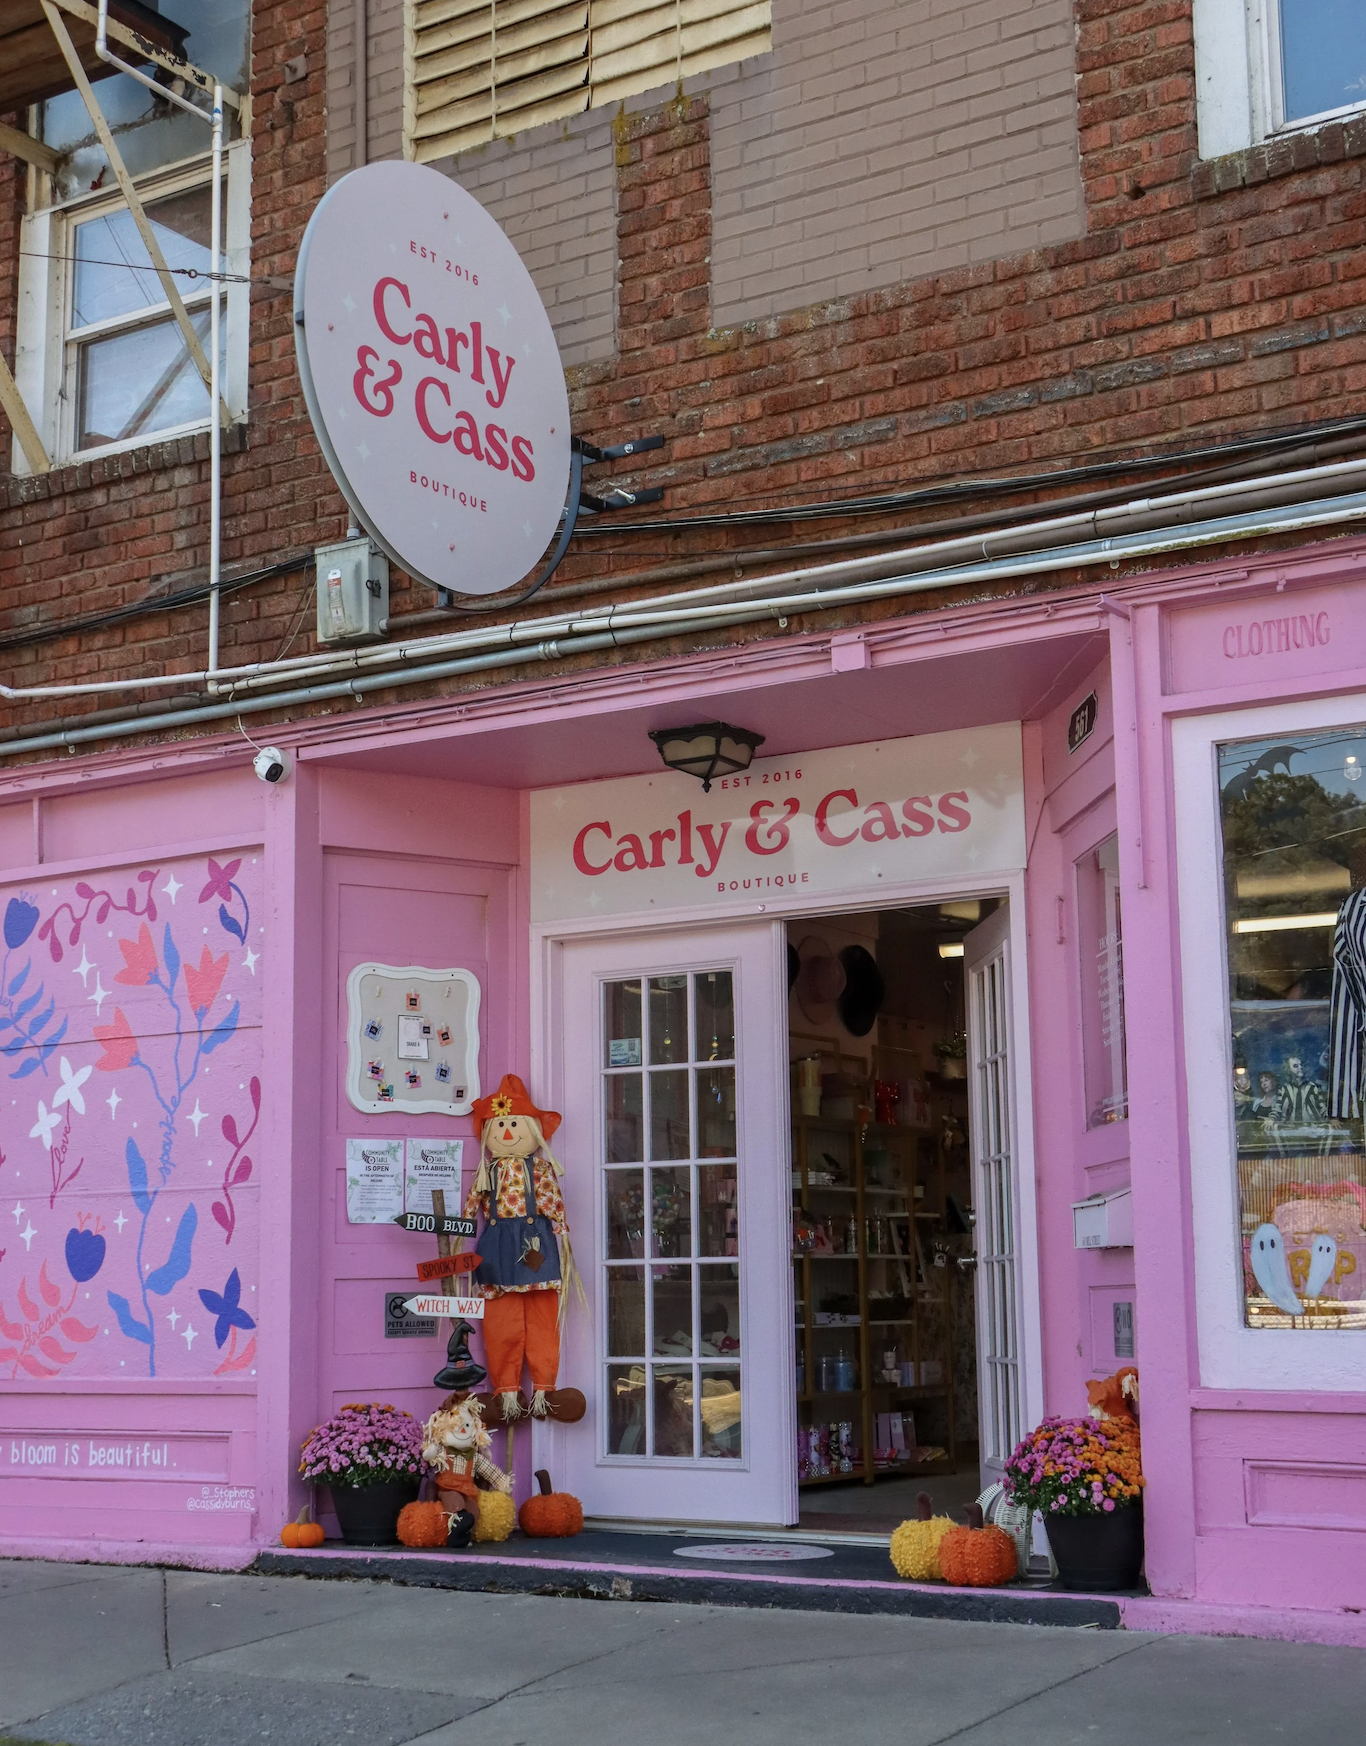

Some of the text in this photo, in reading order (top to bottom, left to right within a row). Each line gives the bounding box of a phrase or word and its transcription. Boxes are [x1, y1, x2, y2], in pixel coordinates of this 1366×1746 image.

[410, 241, 479, 286] EST 2016
[372, 276, 516, 409] Carly
[352, 345, 536, 483] & Cass
[410, 471, 487, 512] BOUTIQUE
[1222, 611, 1331, 659] CLOTHING
[1074, 705, 1089, 742] 561
[720, 768, 803, 791] EST 2016
[572, 787, 972, 878] Carly & Cass
[717, 872, 810, 892] BOUTIQUE
[405, 1213, 476, 1234] BOO BLVD.
[422, 1254, 476, 1279] SPOOKY ST
[1286, 1249, 1357, 1289] RP
[416, 1298, 484, 1315] WITCH WAY
[11, 1440, 57, 1465] bloom
[64, 1442, 80, 1466] is
[88, 1440, 177, 1468] beautiful.
